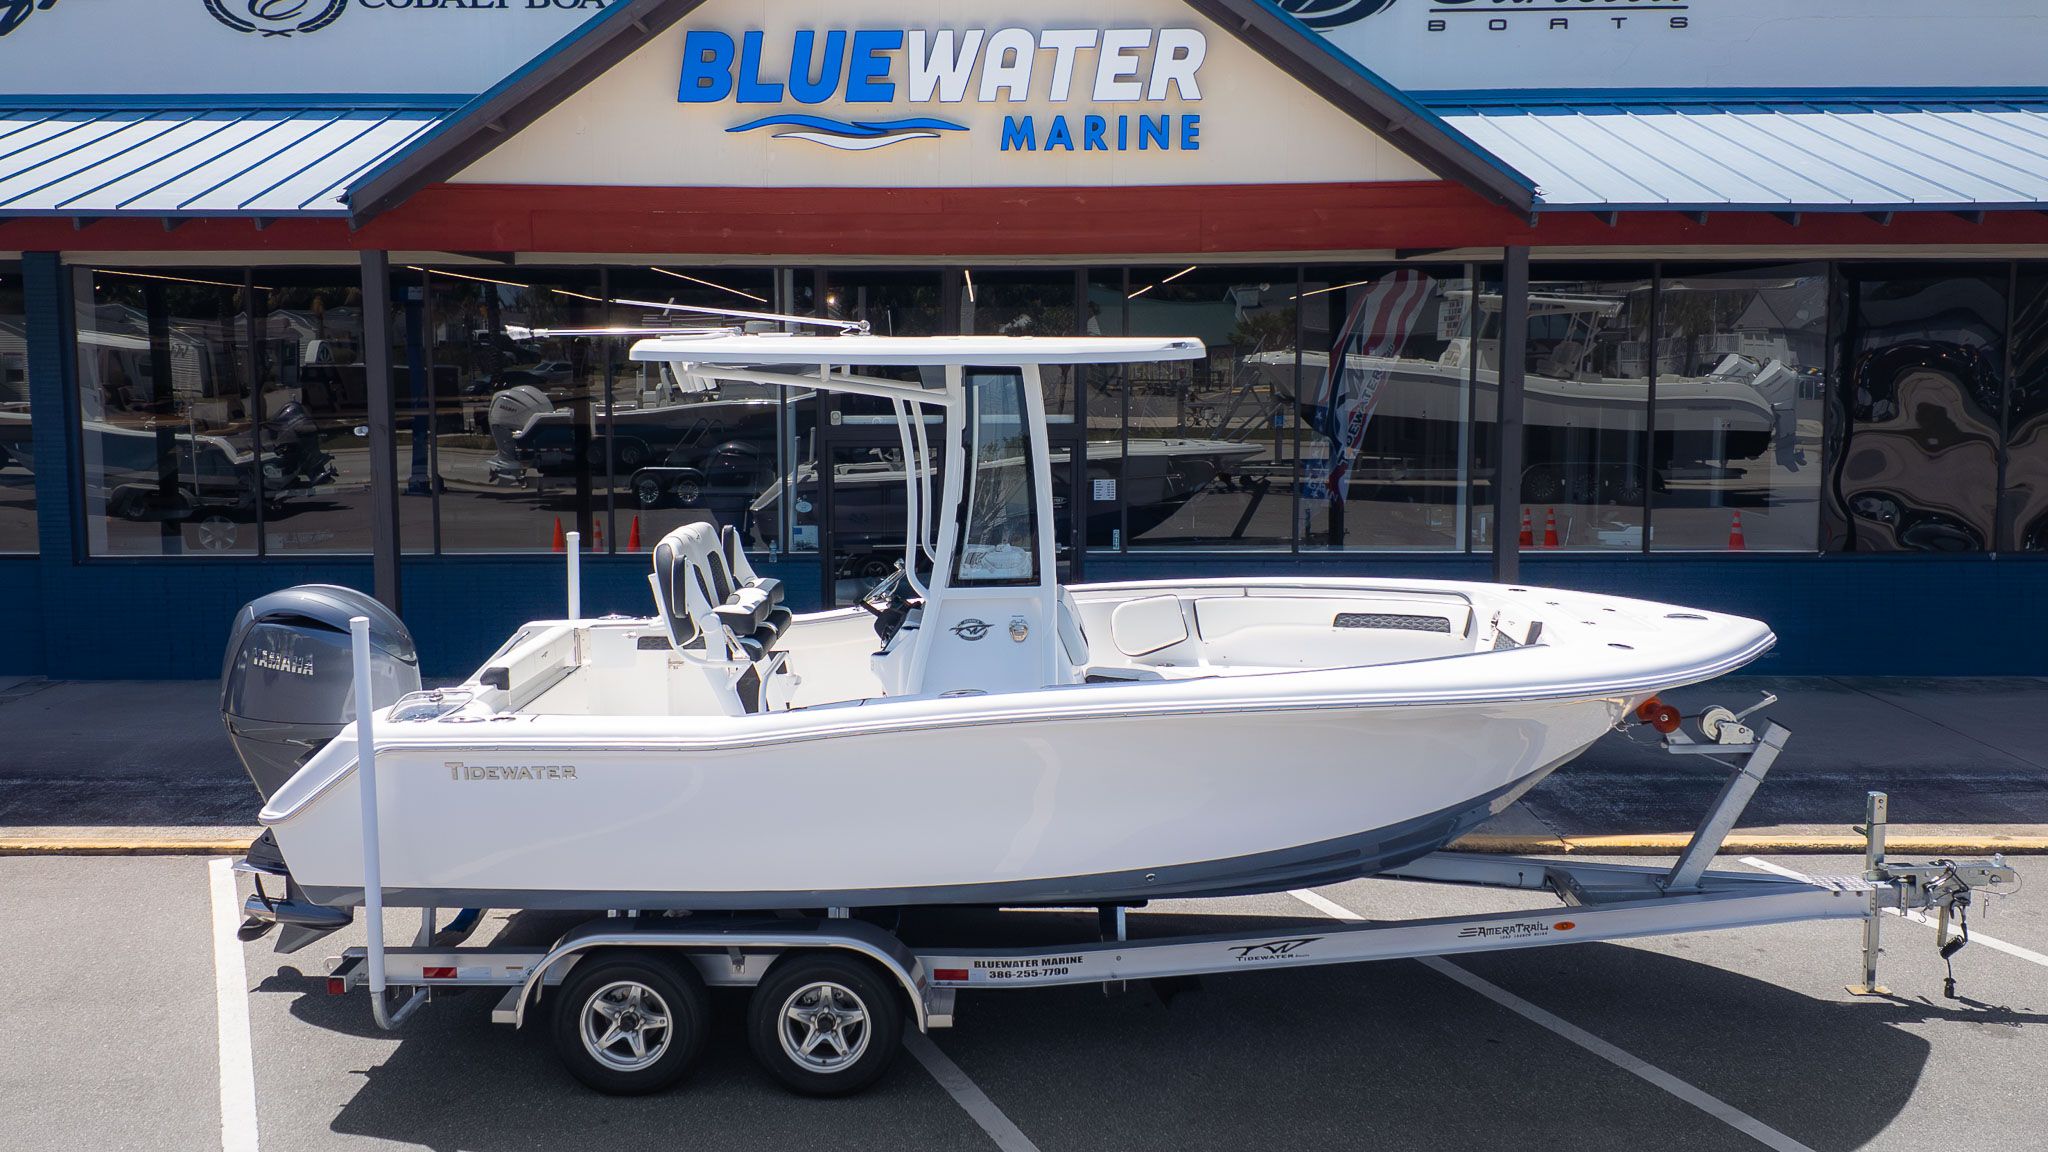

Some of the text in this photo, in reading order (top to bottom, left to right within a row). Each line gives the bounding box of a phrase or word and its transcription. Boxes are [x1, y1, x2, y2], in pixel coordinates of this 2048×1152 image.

[1427, 16, 1690, 31] BOATS
[677, 28, 1207, 104] BLUEWATER
[1000, 115, 1201, 152] MARINE
[253, 647, 314, 677] YAMAHA
[444, 761, 578, 781] TIDEWATER
[973, 955, 1084, 969] BLUEWATER MARINE
[1236, 953, 1294, 962] TIDEWATER
